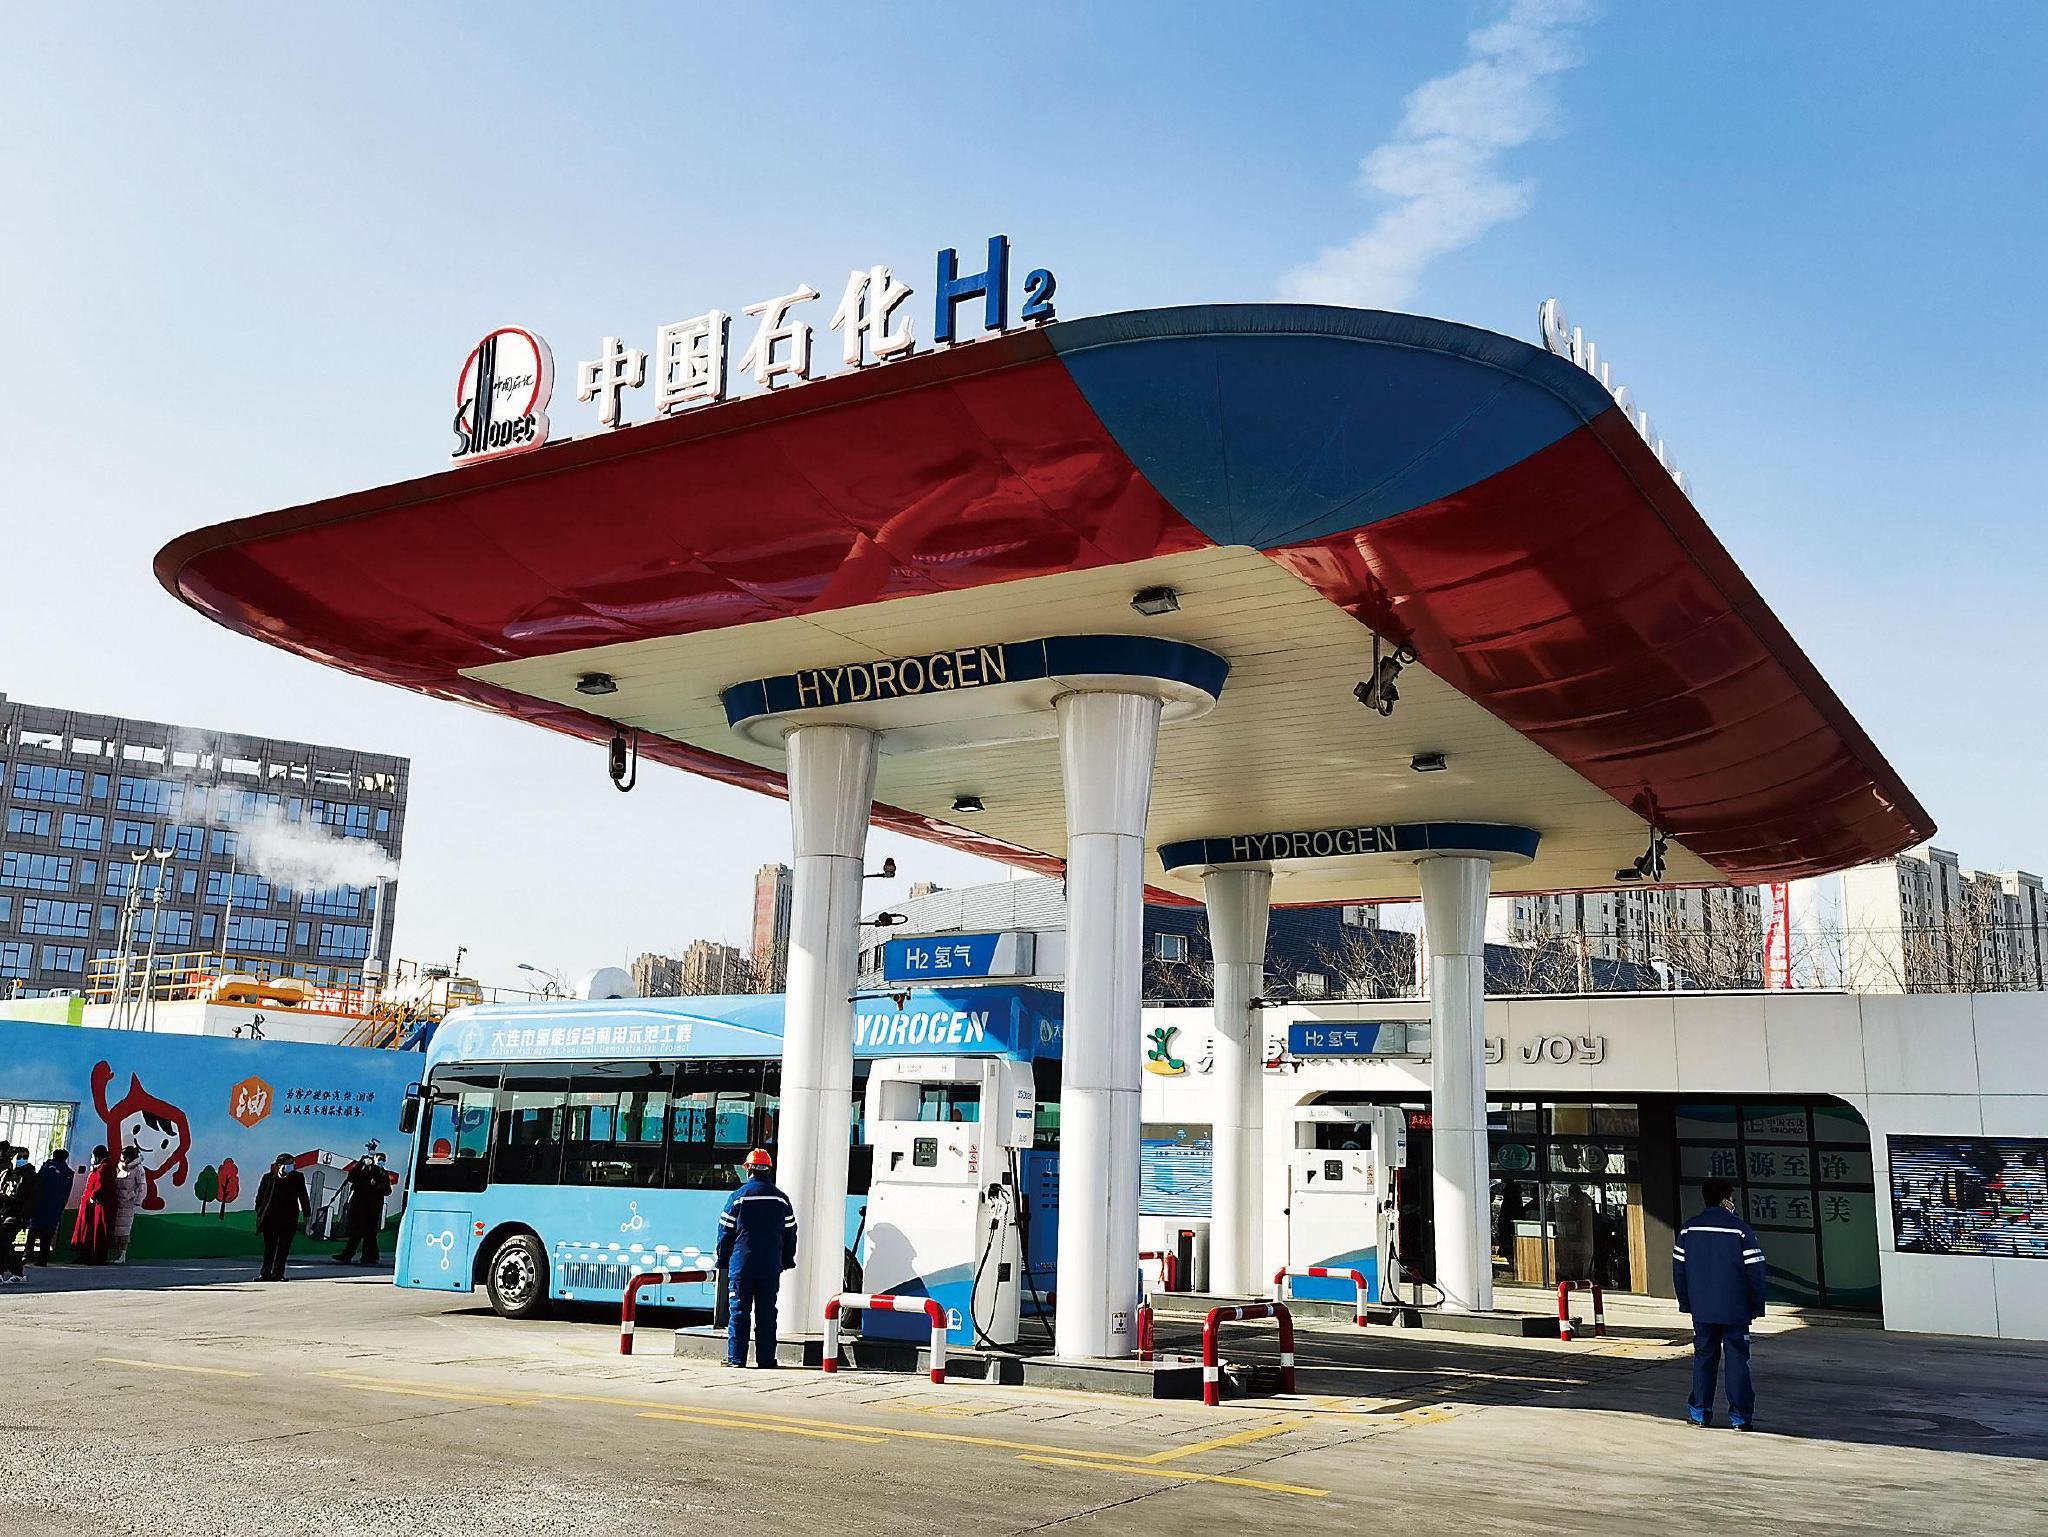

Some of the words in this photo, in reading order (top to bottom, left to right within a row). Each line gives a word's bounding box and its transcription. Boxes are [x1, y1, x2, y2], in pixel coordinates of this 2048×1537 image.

[577, 264, 914, 426] 中国石化
[934, 235, 1057, 343] H2
[797, 645, 1006, 707] HYDROGEN
[1231, 825, 1397, 860] HYDROGEN
[906, 948, 929, 970] H2
[934, 945, 971, 969] 氢气
[855, 1011, 989, 1046] YDROGEN
[1305, 1031, 1324, 1047] H2
[1328, 1030, 1359, 1047] 氢气
[236, 1085, 268, 1118] 油
[1710, 1151, 1850, 1180] 能源至净
[1752, 1193, 1852, 1223] 活至美
